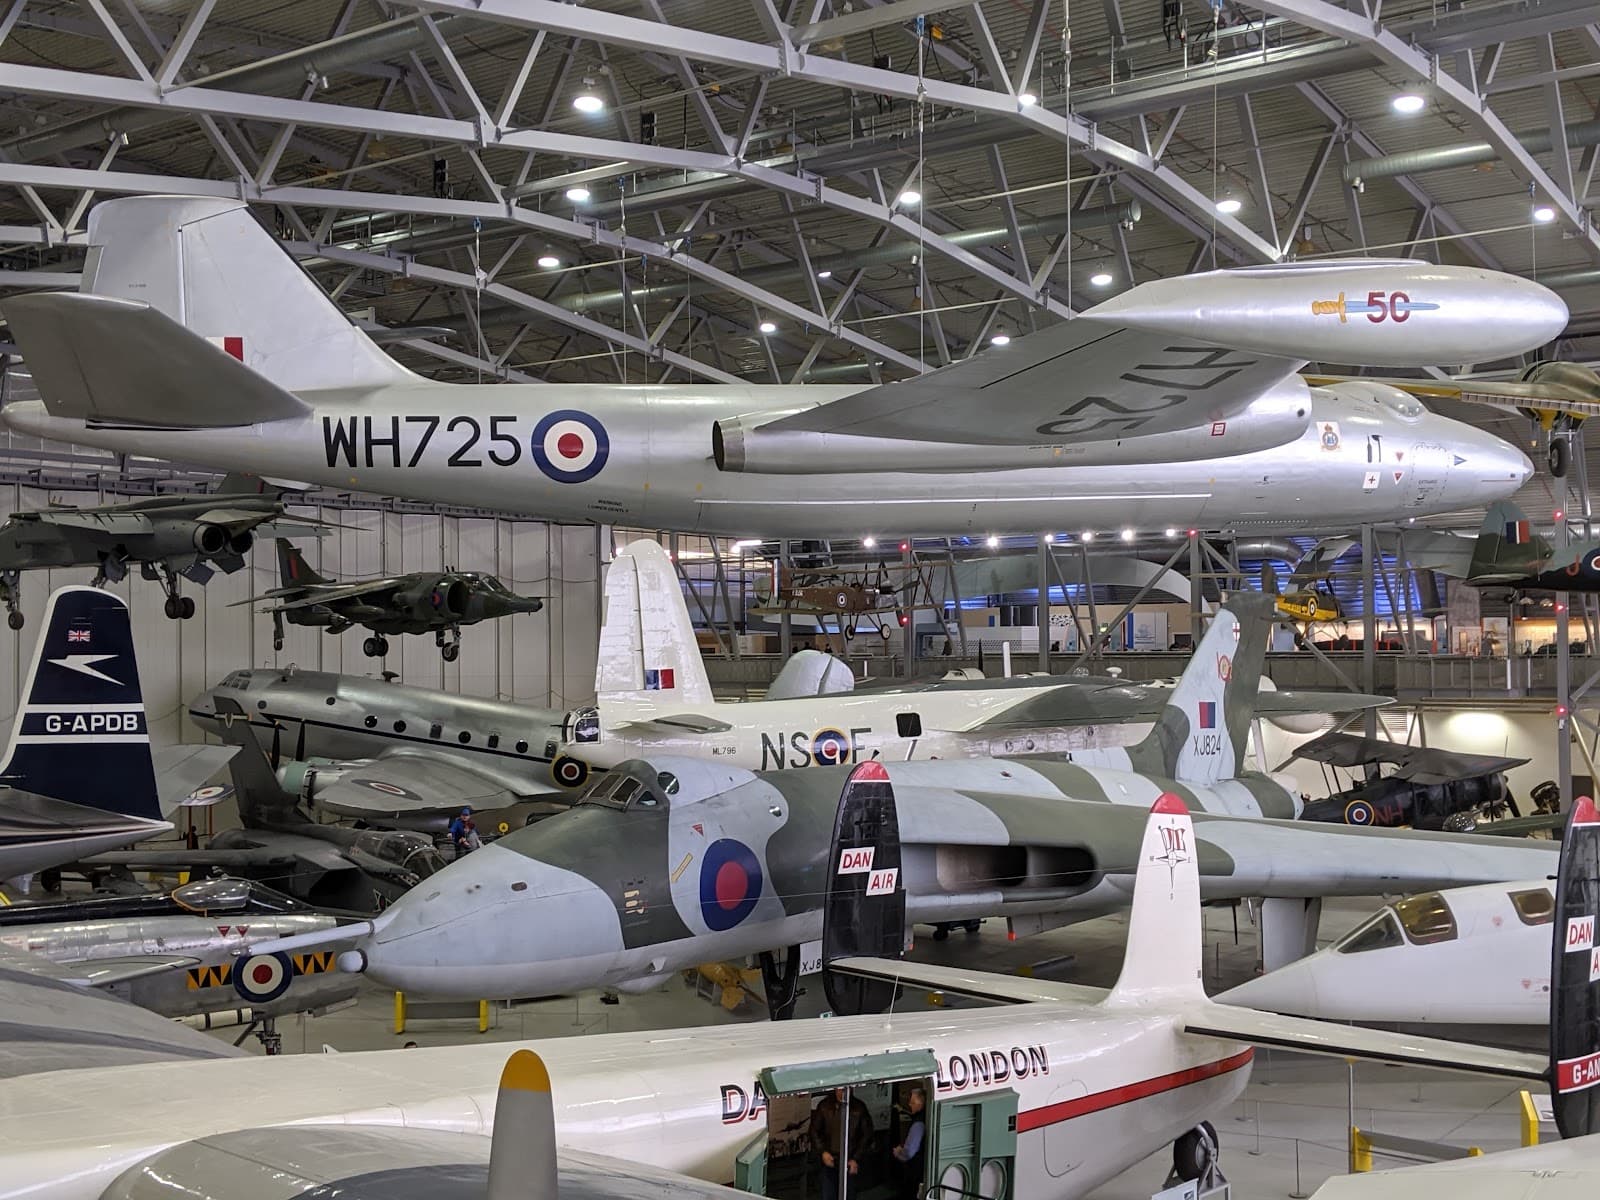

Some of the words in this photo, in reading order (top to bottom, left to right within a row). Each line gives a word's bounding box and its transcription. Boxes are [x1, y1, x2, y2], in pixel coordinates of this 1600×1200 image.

[322, 415, 522, 468] WH725
[46, 713, 138, 732] G-APDB
[712, 746, 737, 756] ML796
[761, 731, 812, 772] NS
[1193, 734, 1221, 757] XJ824
[842, 851, 872, 869] DAN
[871, 873, 894, 890] AIR
[1568, 922, 1592, 945] DAN
[801, 959, 822, 973] XJ8
[936, 1044, 1051, 1092] LONDON
